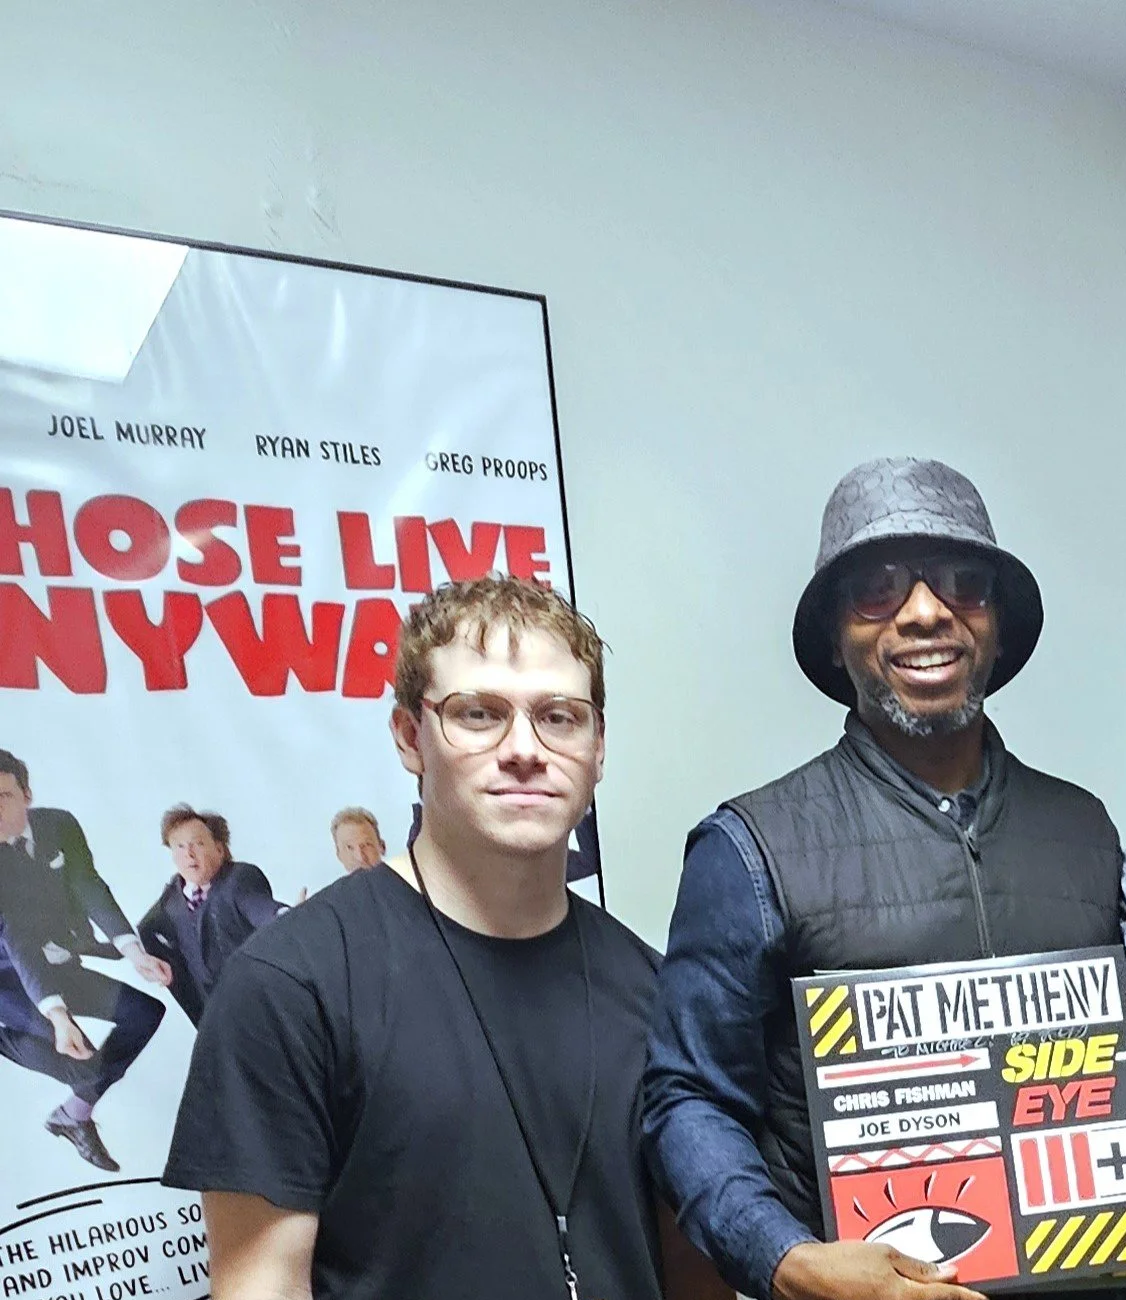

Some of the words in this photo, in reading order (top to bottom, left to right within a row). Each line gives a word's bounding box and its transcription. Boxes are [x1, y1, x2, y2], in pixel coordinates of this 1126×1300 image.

[47, 414, 105, 442] JOEL
[114, 421, 207, 450] MURRAY
[255, 434, 310, 460] RYAN
[320, 441, 382, 467] STILES
[424, 451, 474, 476] GREG
[481, 457, 549, 482] PROOPS
[336, 511, 551, 594] LIVE
[0, 582, 412, 698] NYWA
[862, 984, 924, 1043] PAT
[935, 964, 1111, 1036] METHENY
[833, 1088, 891, 1113] CHRIS
[895, 1080, 977, 1106] FISHMAN
[1012, 1077, 1117, 1127] EYE
[858, 1120, 891, 1139] JOE
[899, 1112, 962, 1132] DYSON
[49, 1211, 168, 1255] HILARIOUS
[3, 1268, 52, 1297] AND
[64, 1245, 150, 1284] IMPROV
